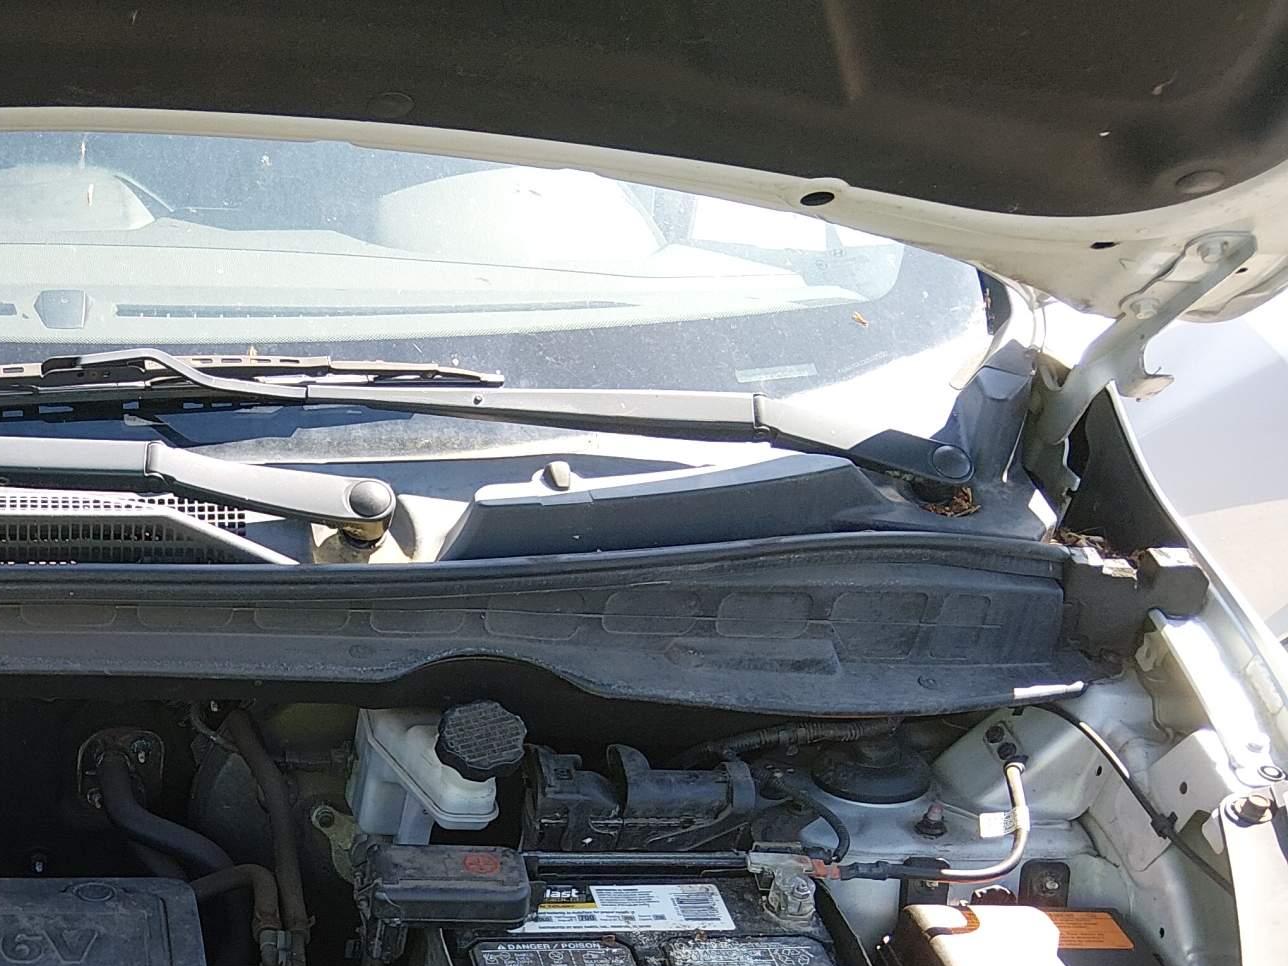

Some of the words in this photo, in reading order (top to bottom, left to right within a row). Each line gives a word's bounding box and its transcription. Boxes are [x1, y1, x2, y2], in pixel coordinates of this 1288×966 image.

[545, 888, 580, 899] last
[507, 943, 551, 951] DANGER
[561, 942, 602, 951] POISON
